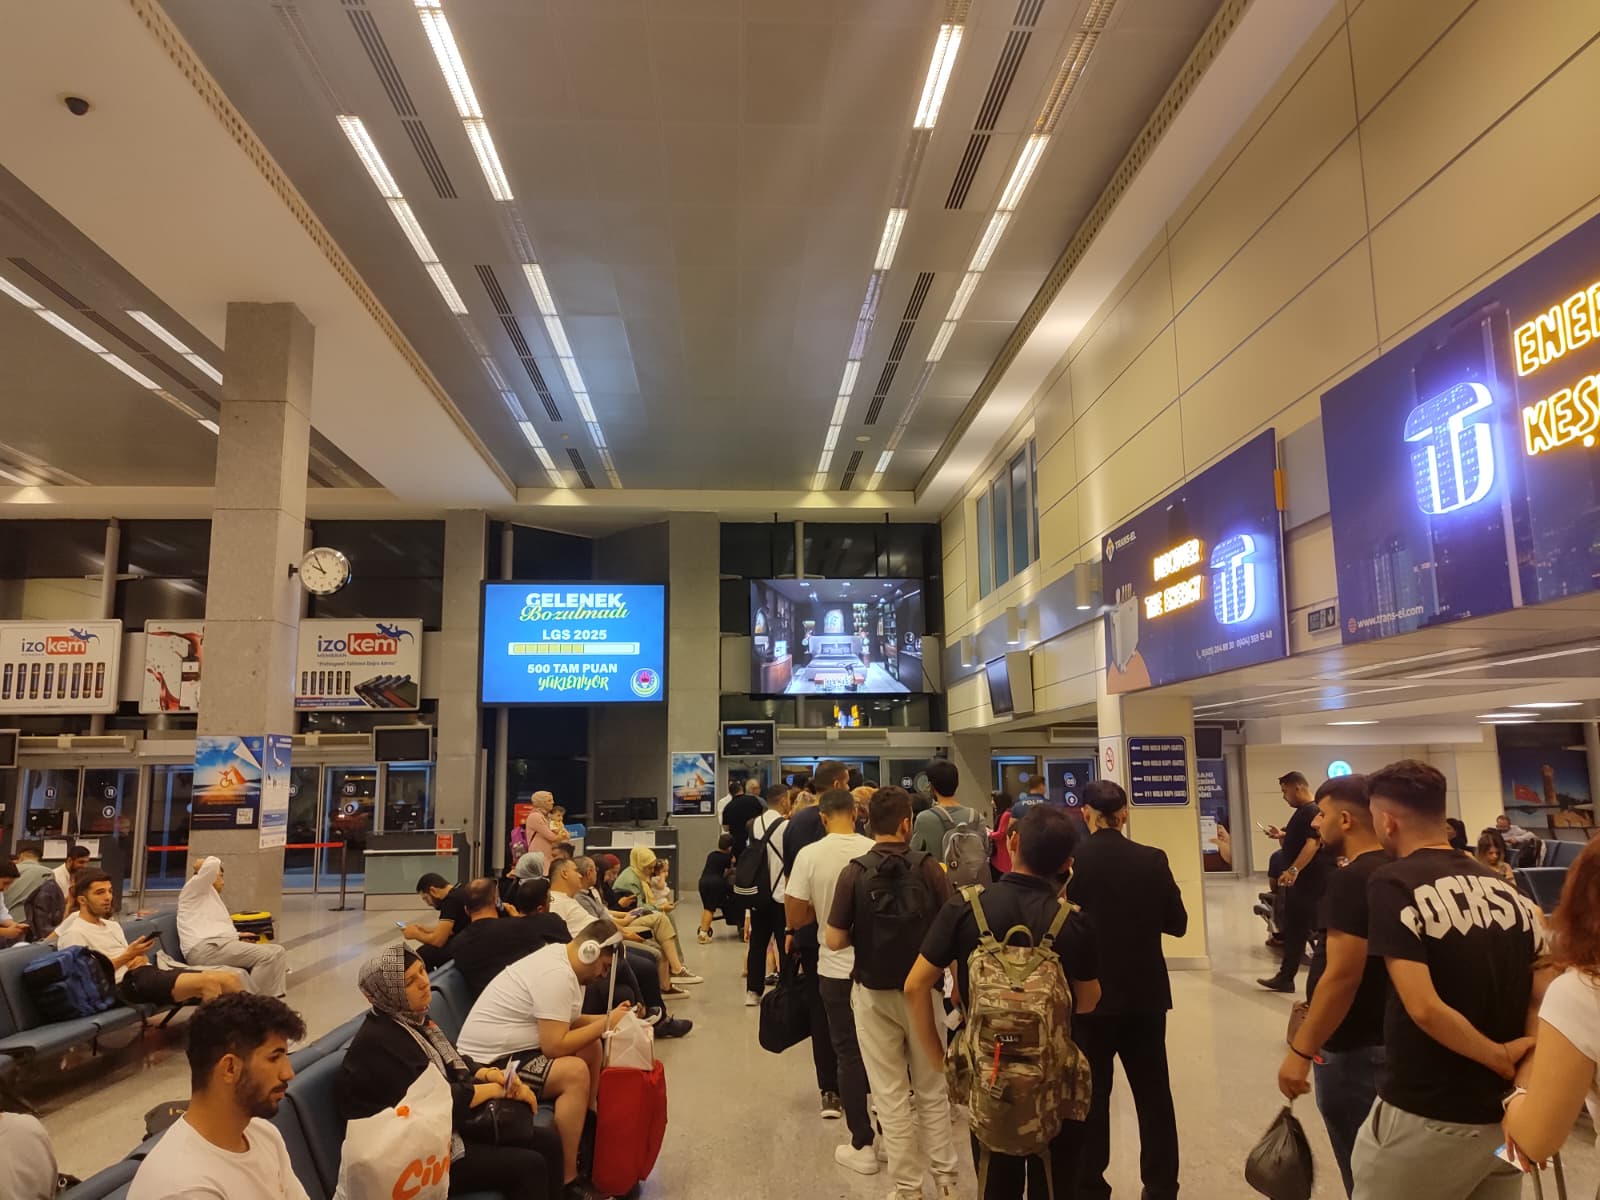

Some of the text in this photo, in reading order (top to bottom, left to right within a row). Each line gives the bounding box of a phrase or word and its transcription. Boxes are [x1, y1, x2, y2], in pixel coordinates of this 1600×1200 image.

[1522, 373, 1600, 457] KEŞ
[525, 592, 624, 609] GELENEK
[518, 602, 630, 622] Bozulmadı
[1358, 605, 1425, 629] www.trans-el.com
[542, 629, 608, 641] LGS 2025
[527, 663, 618, 674] 500 TAM PUAN
[392, 1153, 451, 1200] Civ
